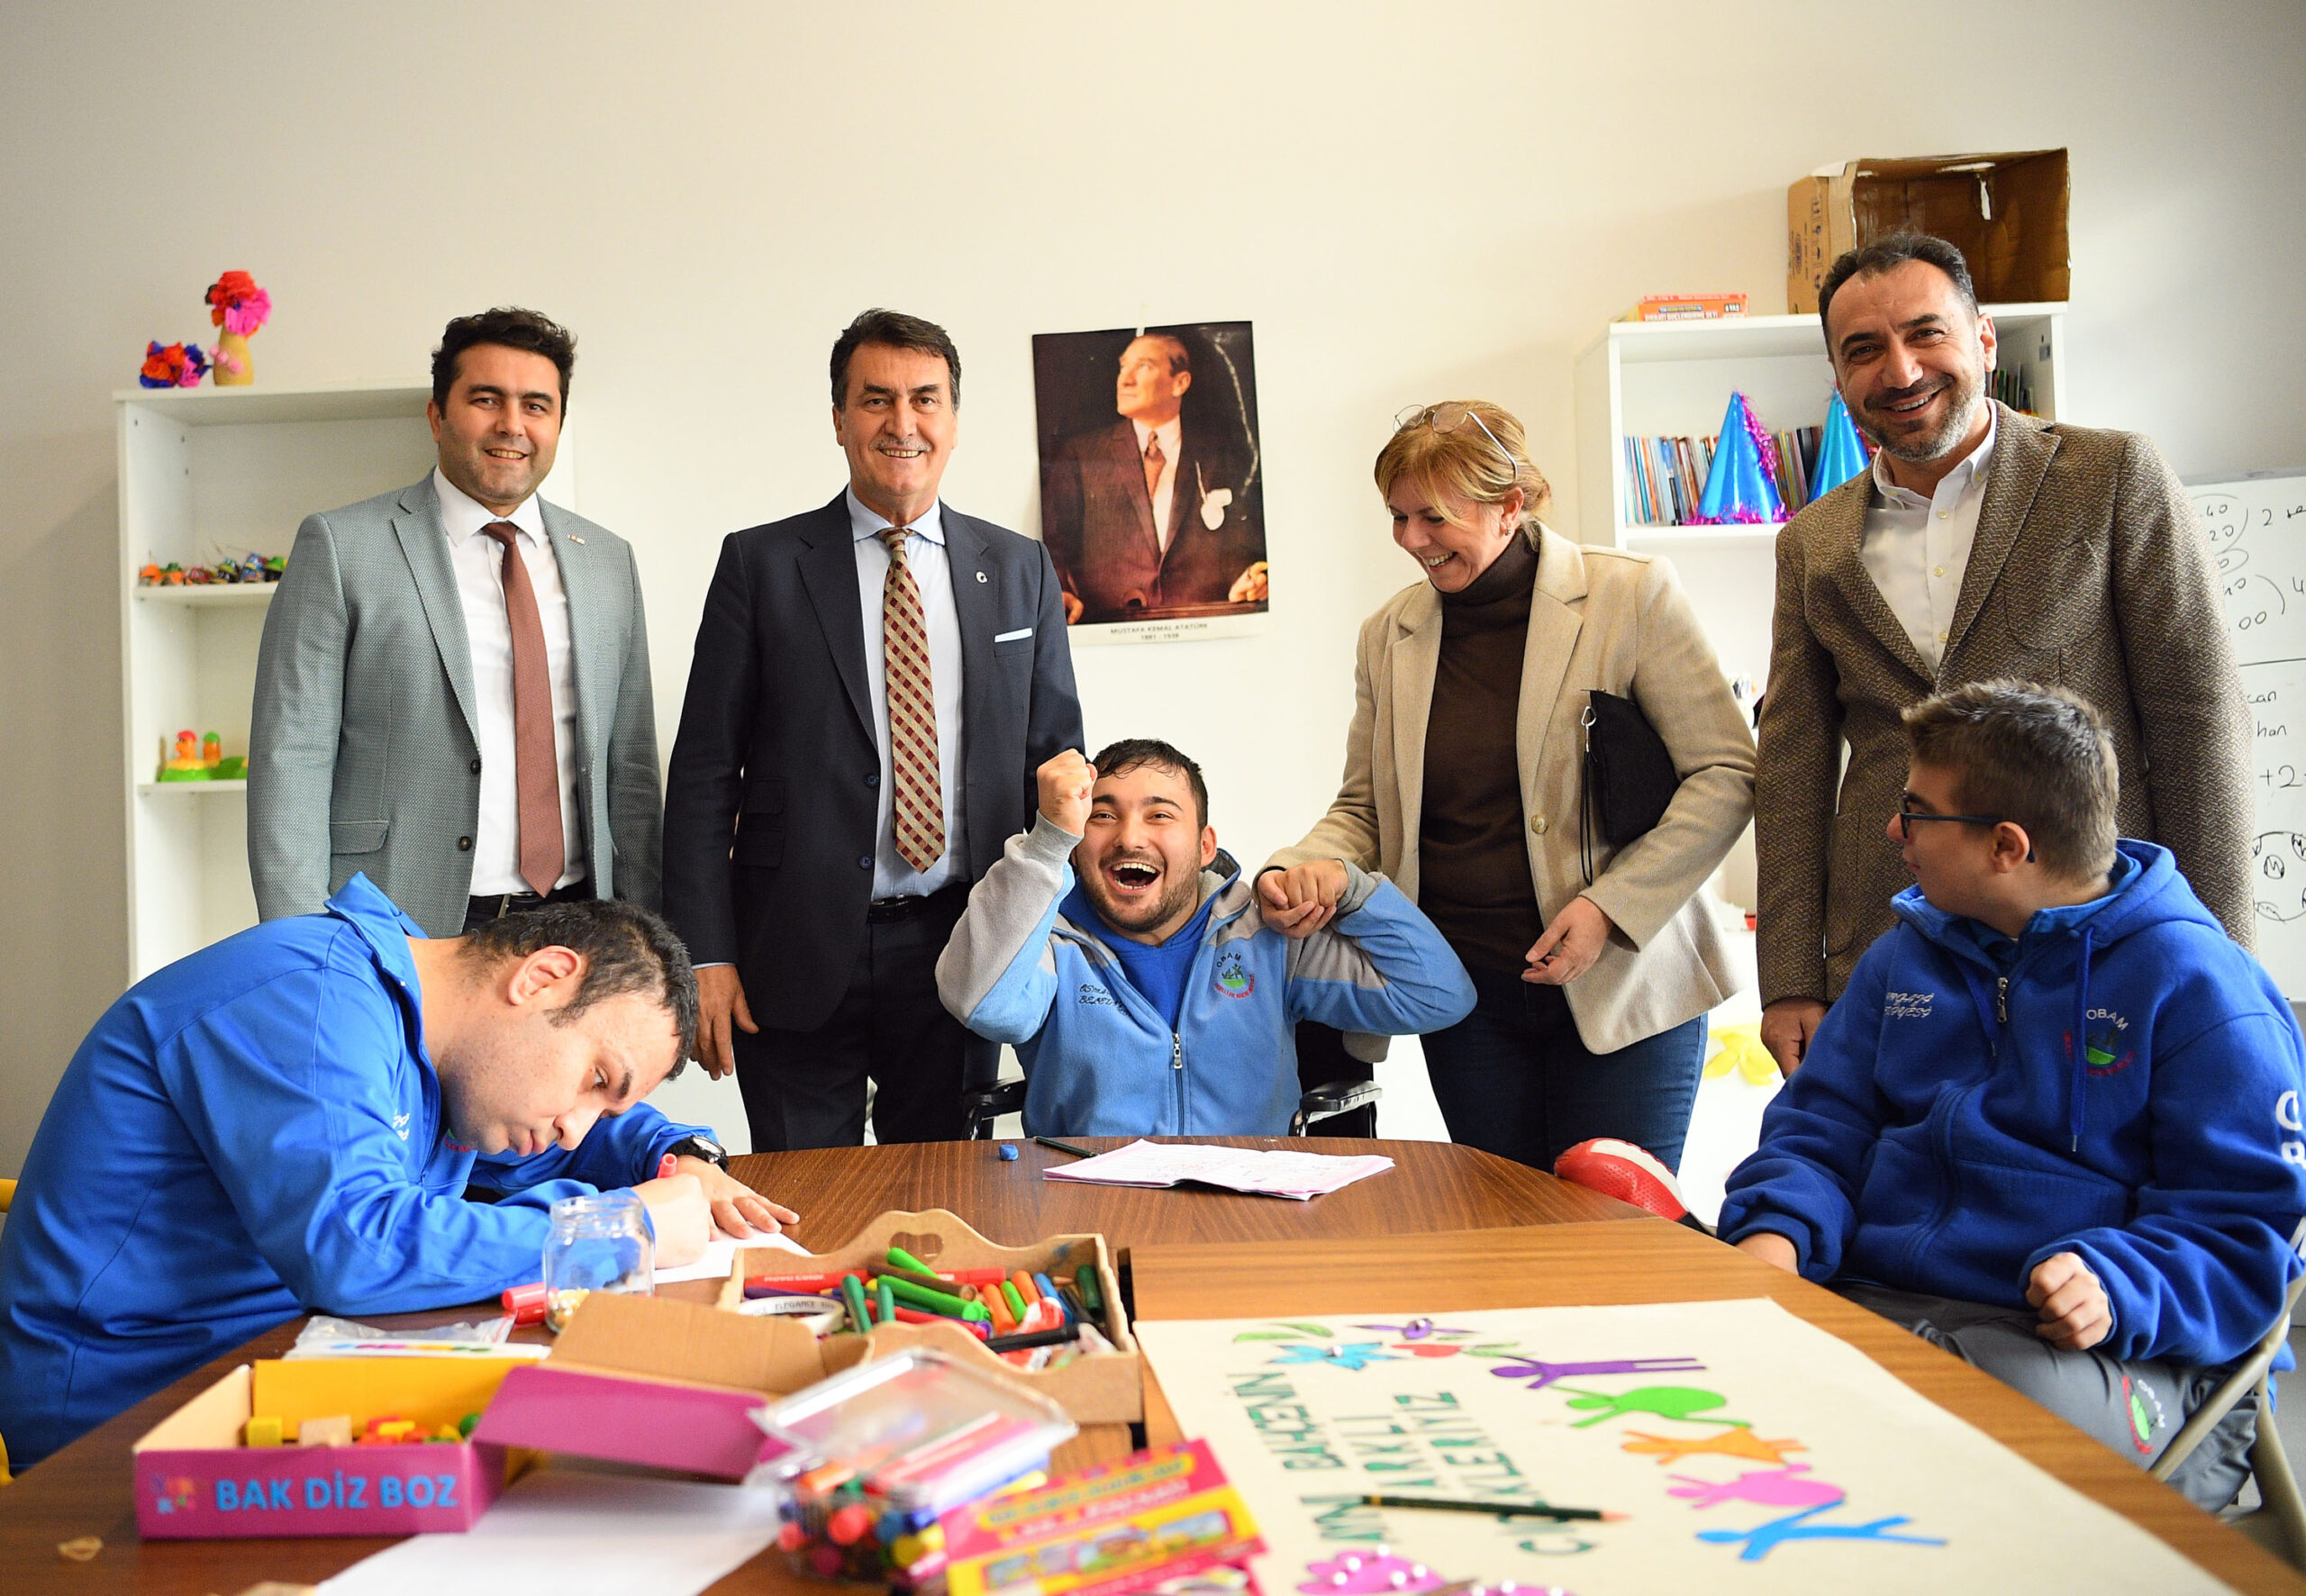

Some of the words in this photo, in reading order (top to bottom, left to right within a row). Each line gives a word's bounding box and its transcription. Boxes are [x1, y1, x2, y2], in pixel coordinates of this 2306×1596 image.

[1216, 951, 1241, 967] OBAM
[2086, 1008, 2129, 1030] OBAM
[1332, 1415, 1448, 1492] ARKLI
[214, 1479, 294, 1511] BAK
[304, 1468, 368, 1510] DİZ
[379, 1474, 458, 1509] BOZ
